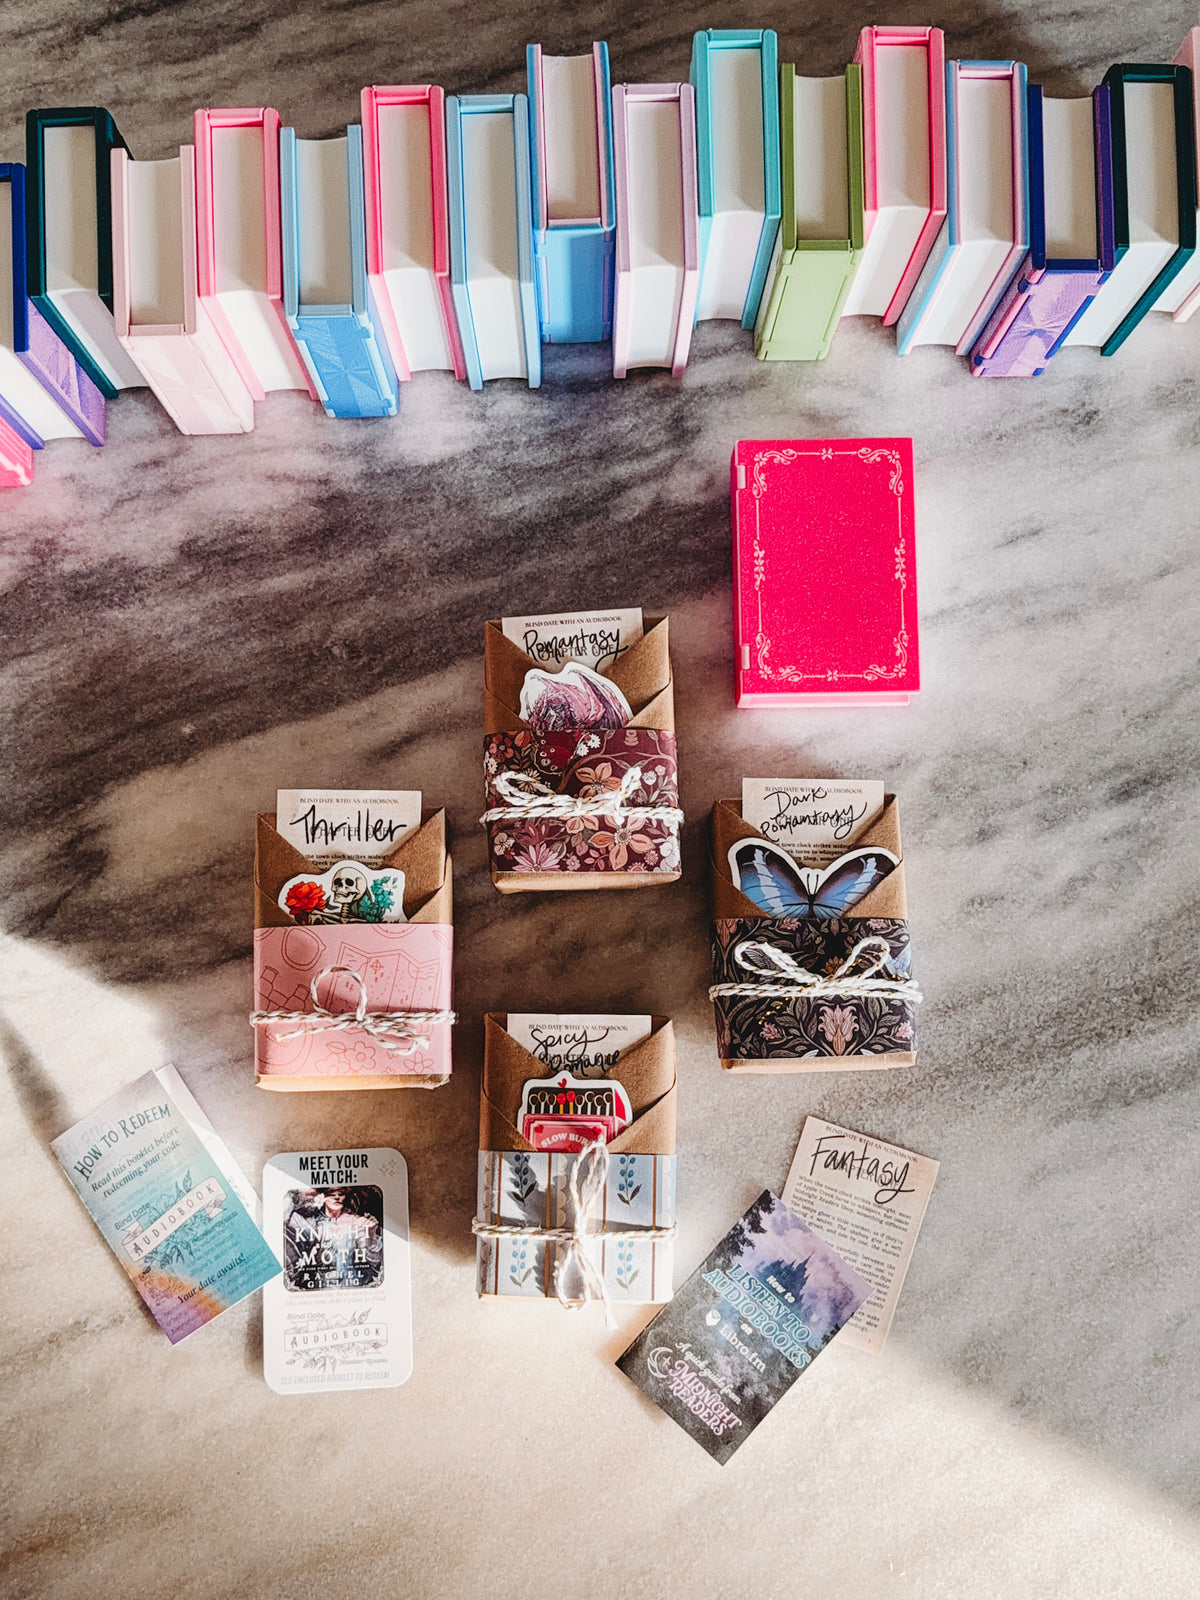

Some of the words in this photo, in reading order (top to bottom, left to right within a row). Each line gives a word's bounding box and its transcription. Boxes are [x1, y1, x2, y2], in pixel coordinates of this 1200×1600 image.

[523, 628, 629, 672] Romantasy
[763, 786, 828, 820] Dark
[289, 804, 407, 846] Thriller
[531, 1027, 609, 1062] Spicy
[73, 1145, 105, 1183] HOW
[100, 1129, 120, 1150] TO
[118, 1103, 172, 1138] REDEEM
[541, 1132, 568, 1148] SLOW
[89, 1172, 112, 1192] Read
[109, 1162, 127, 1177] this
[124, 1142, 155, 1167] booklet
[152, 1123, 181, 1149] before
[100, 1164, 144, 1200] redeeming
[140, 1152, 163, 1172] your
[159, 1138, 181, 1156] code
[299, 1156, 332, 1171] MEET
[336, 1154, 369, 1169] YOUR
[809, 1135, 916, 1204] Fantasy
[311, 1169, 358, 1185] MATCH:
[113, 1213, 133, 1230] Blind
[131, 1200, 151, 1218] Date
[133, 1183, 215, 1257] AUDIOBOOK
[302, 1248, 367, 1266] MOTH
[176, 1284, 199, 1304] Your
[195, 1272, 216, 1291] date
[213, 1251, 246, 1278] awaits!
[307, 1278, 360, 1289] GILLIG
[766, 1274, 787, 1294] How
[783, 1291, 796, 1304] to
[287, 1312, 306, 1320] Blind
[702, 1268, 811, 1370] AUDIOBOOKS
[726, 1263, 790, 1322] LISTEN
[782, 1315, 812, 1344] TO
[290, 1327, 381, 1349] AUDIOBOOK
[740, 1322, 753, 1336] on
[675, 1340, 691, 1354] A
[682, 1348, 707, 1371] quick
[719, 1324, 766, 1373] Libro.fm
[698, 1363, 728, 1390] guide
[667, 1359, 743, 1431] MIDNIGHT
[669, 1376, 728, 1436] READERS
[720, 1382, 742, 1407] from
